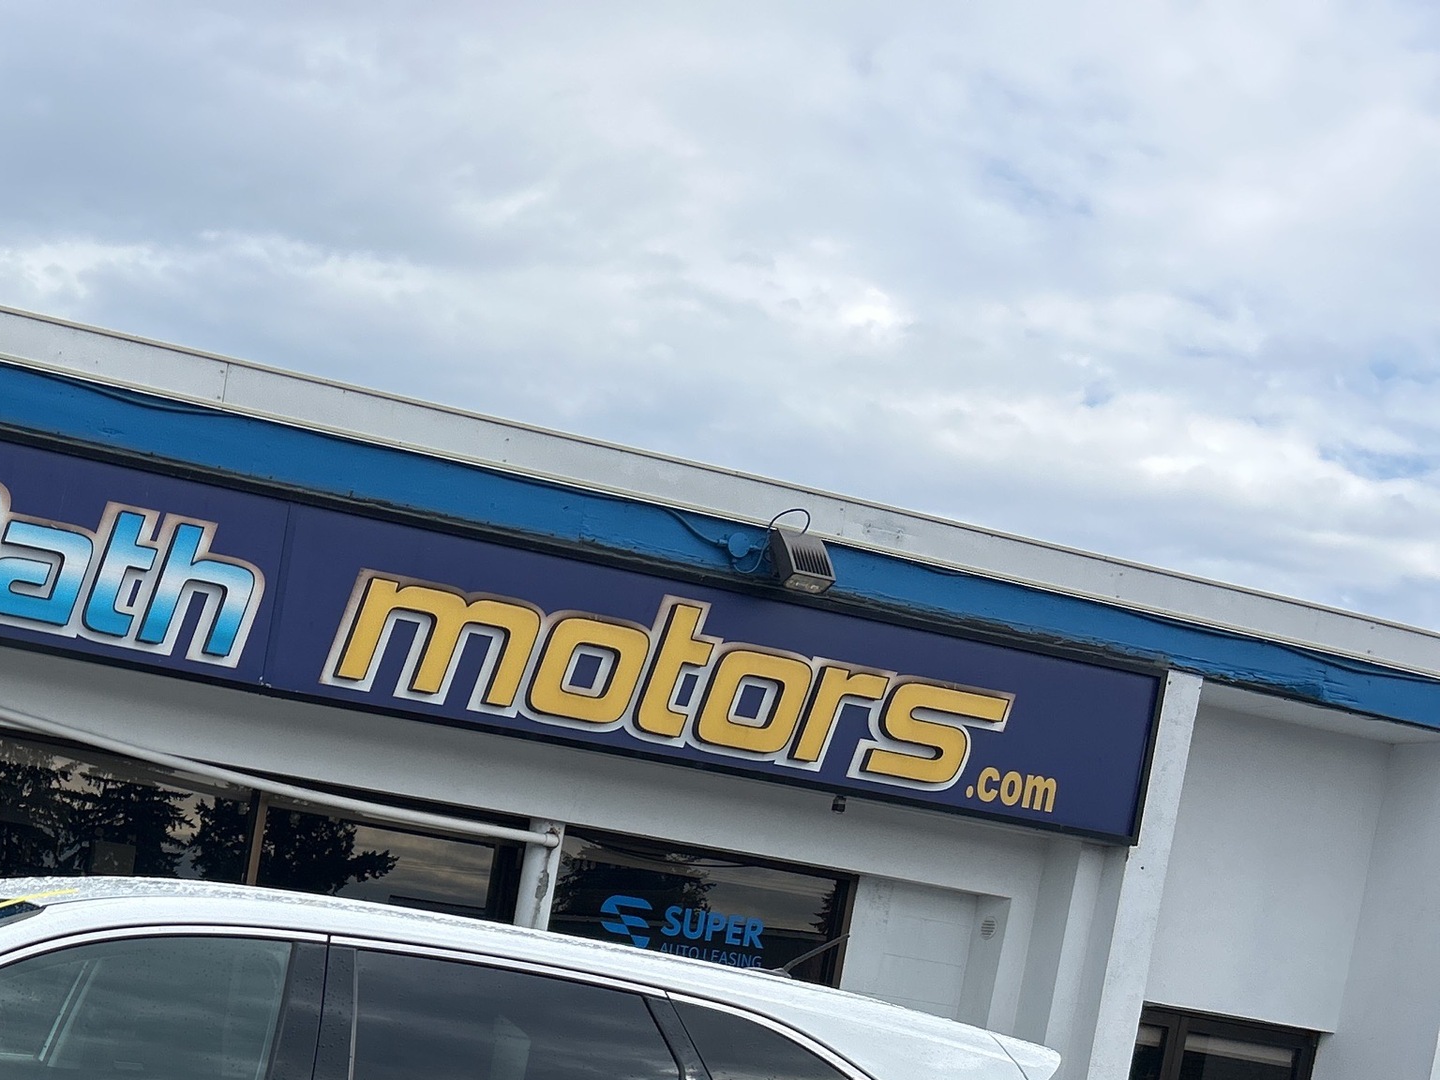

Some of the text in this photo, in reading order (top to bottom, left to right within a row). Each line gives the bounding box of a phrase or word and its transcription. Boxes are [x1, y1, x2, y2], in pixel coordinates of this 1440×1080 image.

[319, 567, 1014, 790] motors
[966, 767, 1057, 812] .com
[660, 905, 764, 949] SUPER
